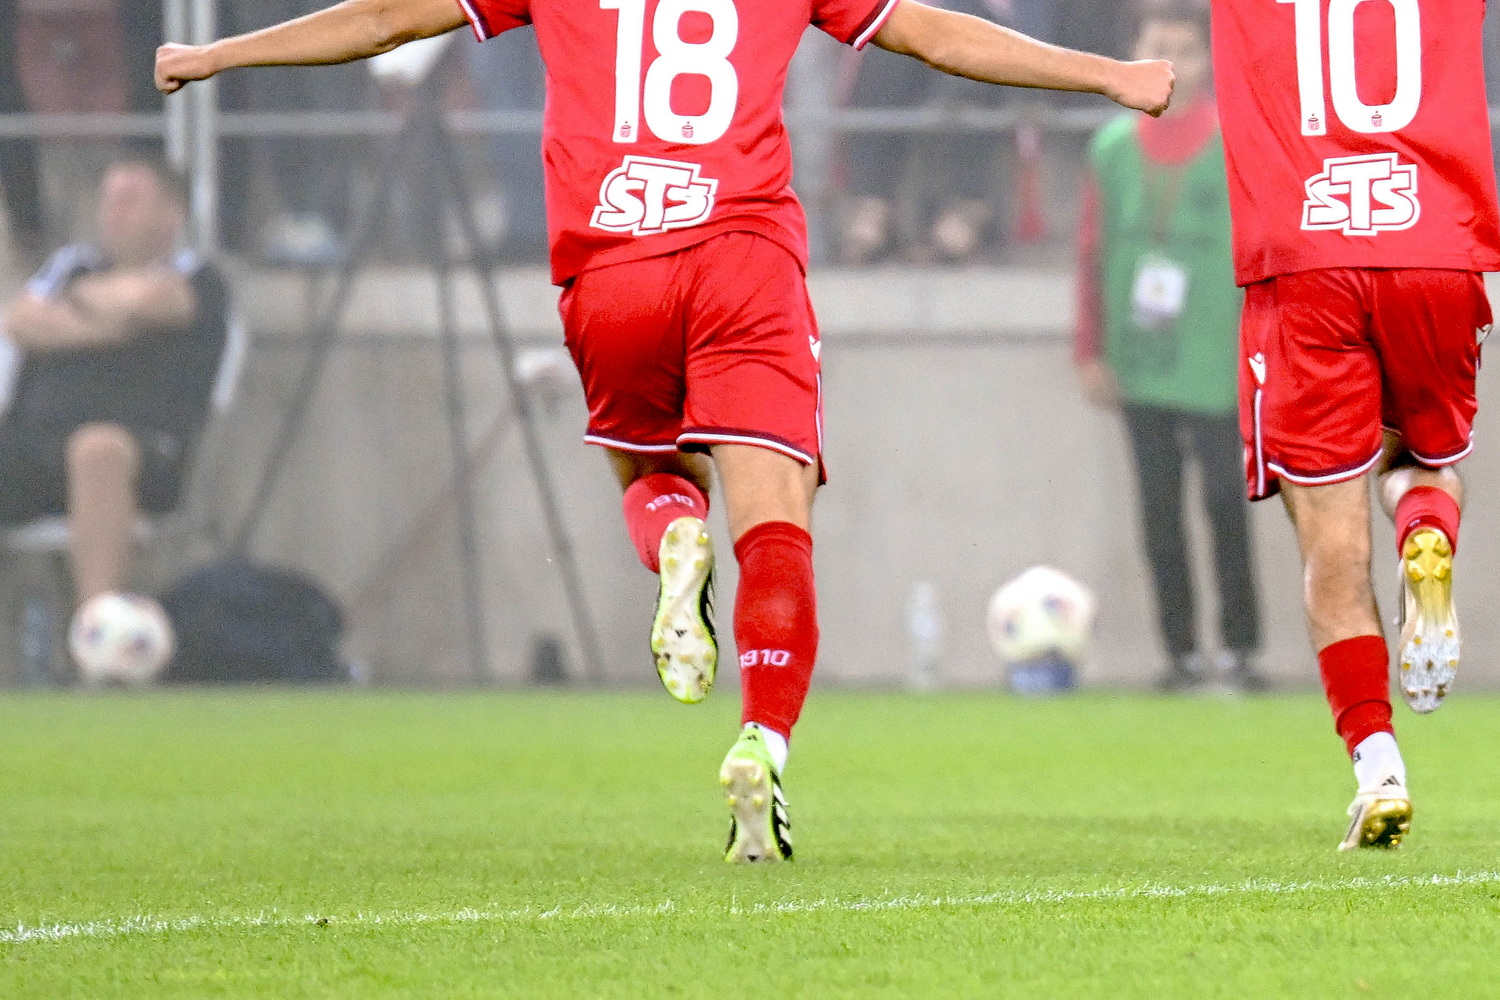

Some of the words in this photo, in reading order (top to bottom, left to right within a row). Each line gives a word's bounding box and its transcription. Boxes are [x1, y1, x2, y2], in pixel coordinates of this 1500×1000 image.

[589, 155, 718, 236] STS
[1300, 153, 1421, 236] STS
[740, 649, 790, 668] 1910
